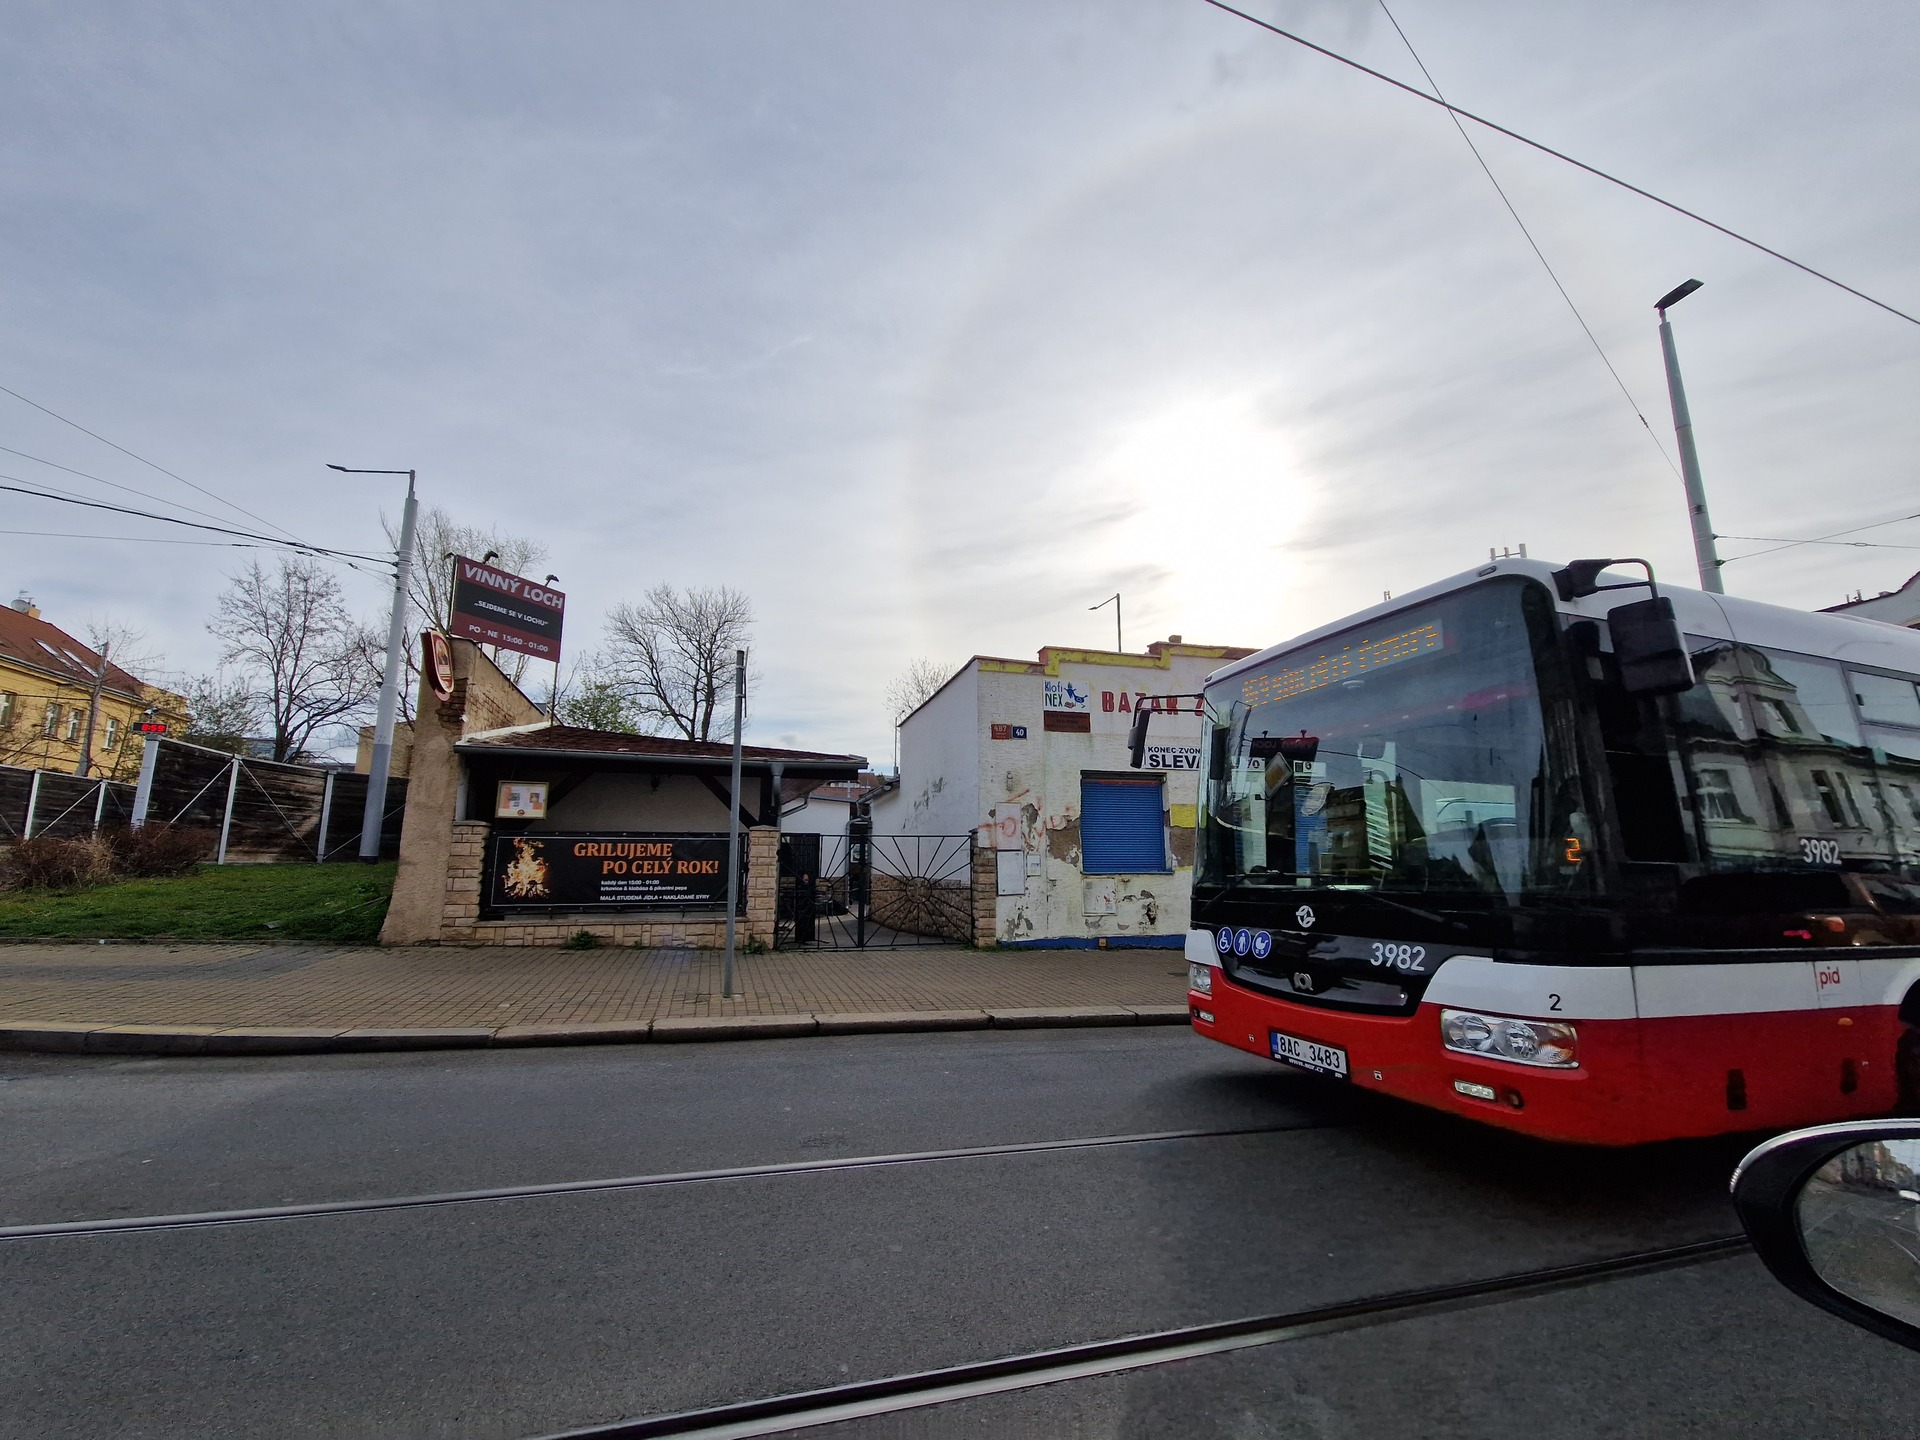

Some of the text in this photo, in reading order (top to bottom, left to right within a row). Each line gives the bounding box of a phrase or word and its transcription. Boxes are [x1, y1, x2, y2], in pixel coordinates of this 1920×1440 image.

[464, 564, 563, 608] VINNÝ LOCH
[508, 609, 517, 618] SE
[469, 624, 481, 633] PO
[488, 630, 498, 638] NE
[502, 634, 523, 645] 15:00
[528, 641, 549, 652] 01:00
[1045, 693, 1063, 707] NEX
[1101, 691, 1179, 716] BAZAR
[1016, 728, 1025, 736] 40
[573, 843, 673, 859] GRILUJEME
[1800, 838, 1842, 865] 3982
[602, 857, 719, 874] PO CELÝ ROK!
[1370, 942, 1426, 972] 3982
[1819, 966, 1841, 989] pid
[1548, 993, 1562, 1011] 2
[1280, 1036, 1340, 1069] 8AC 3483
